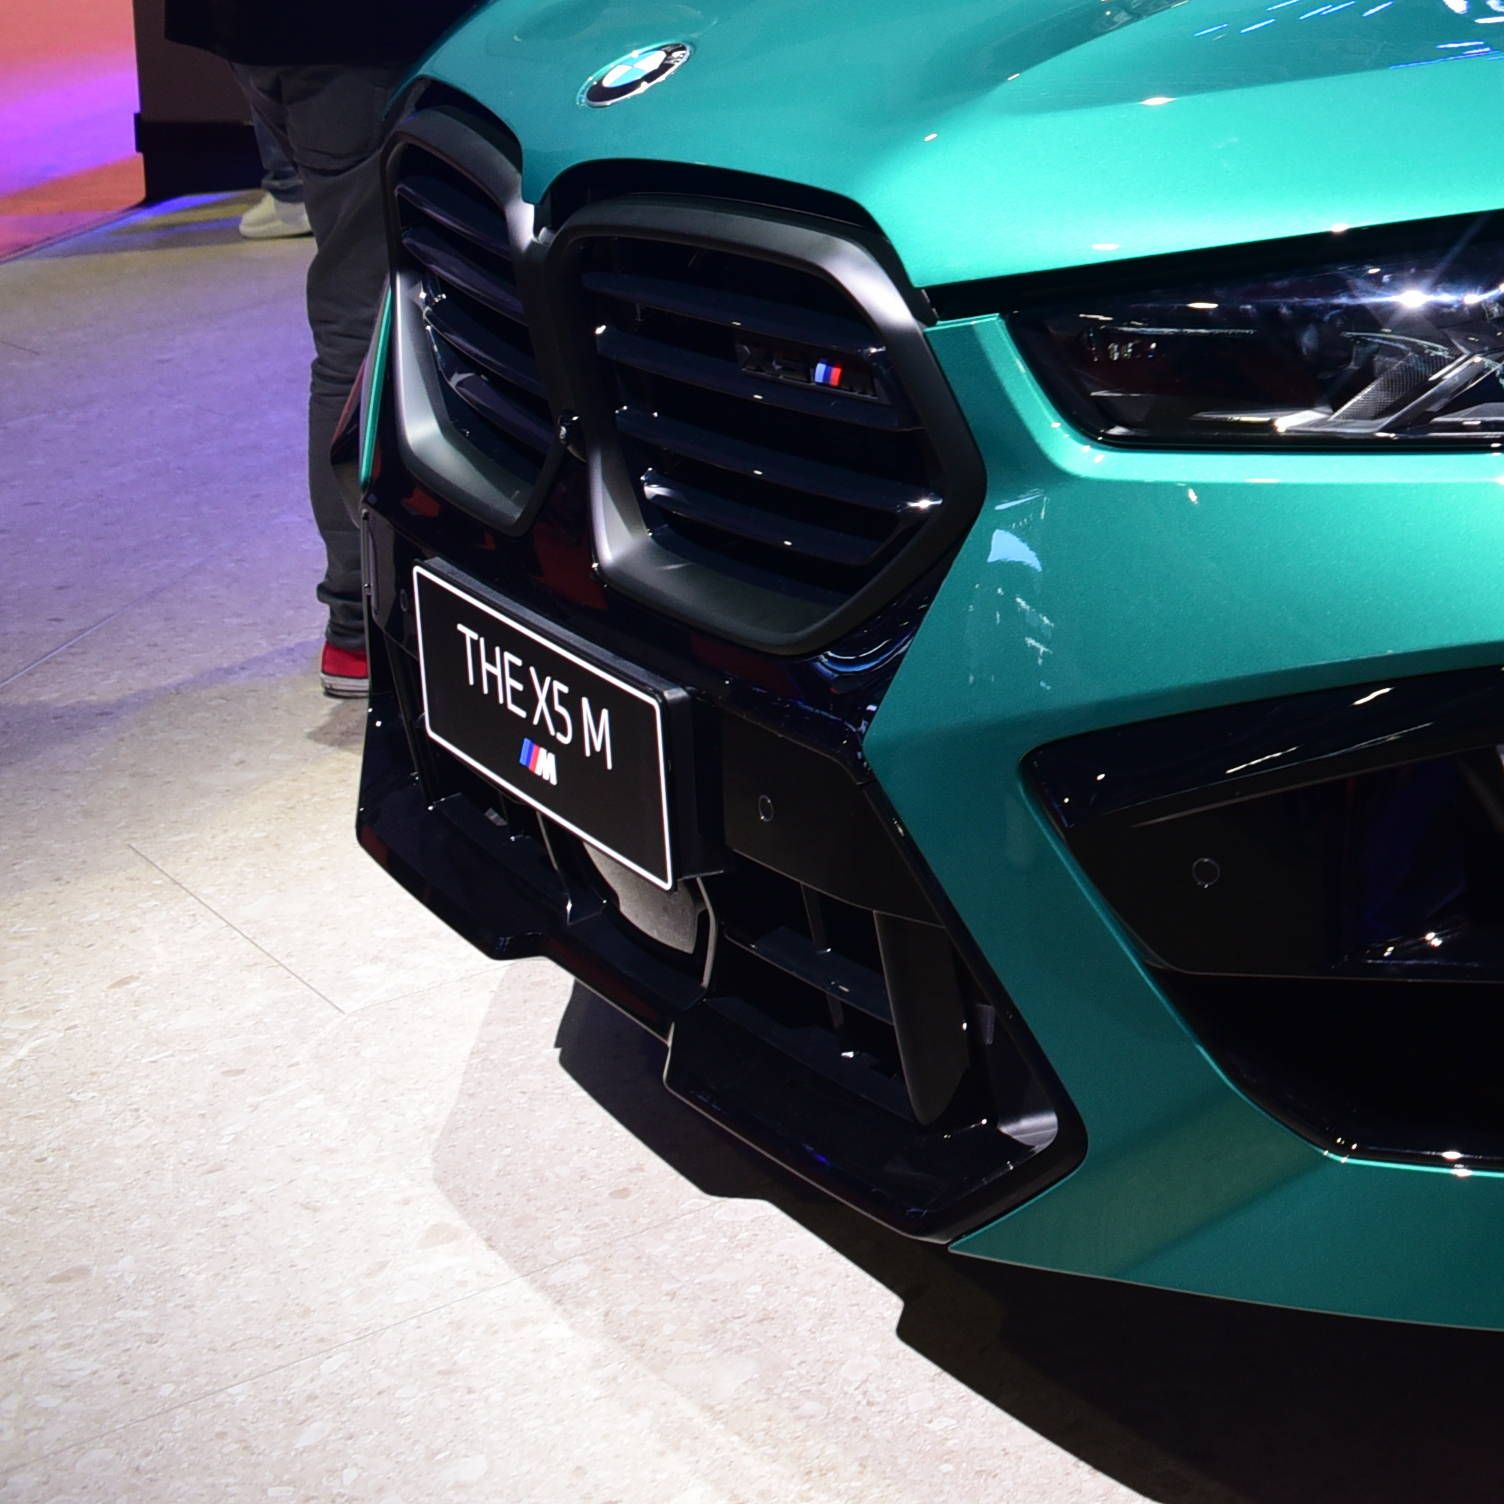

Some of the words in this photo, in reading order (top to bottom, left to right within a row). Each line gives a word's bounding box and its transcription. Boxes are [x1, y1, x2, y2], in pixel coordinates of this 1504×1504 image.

[457, 623, 527, 719] THE
[529, 666, 573, 745] X5
[581, 696, 613, 771] M
